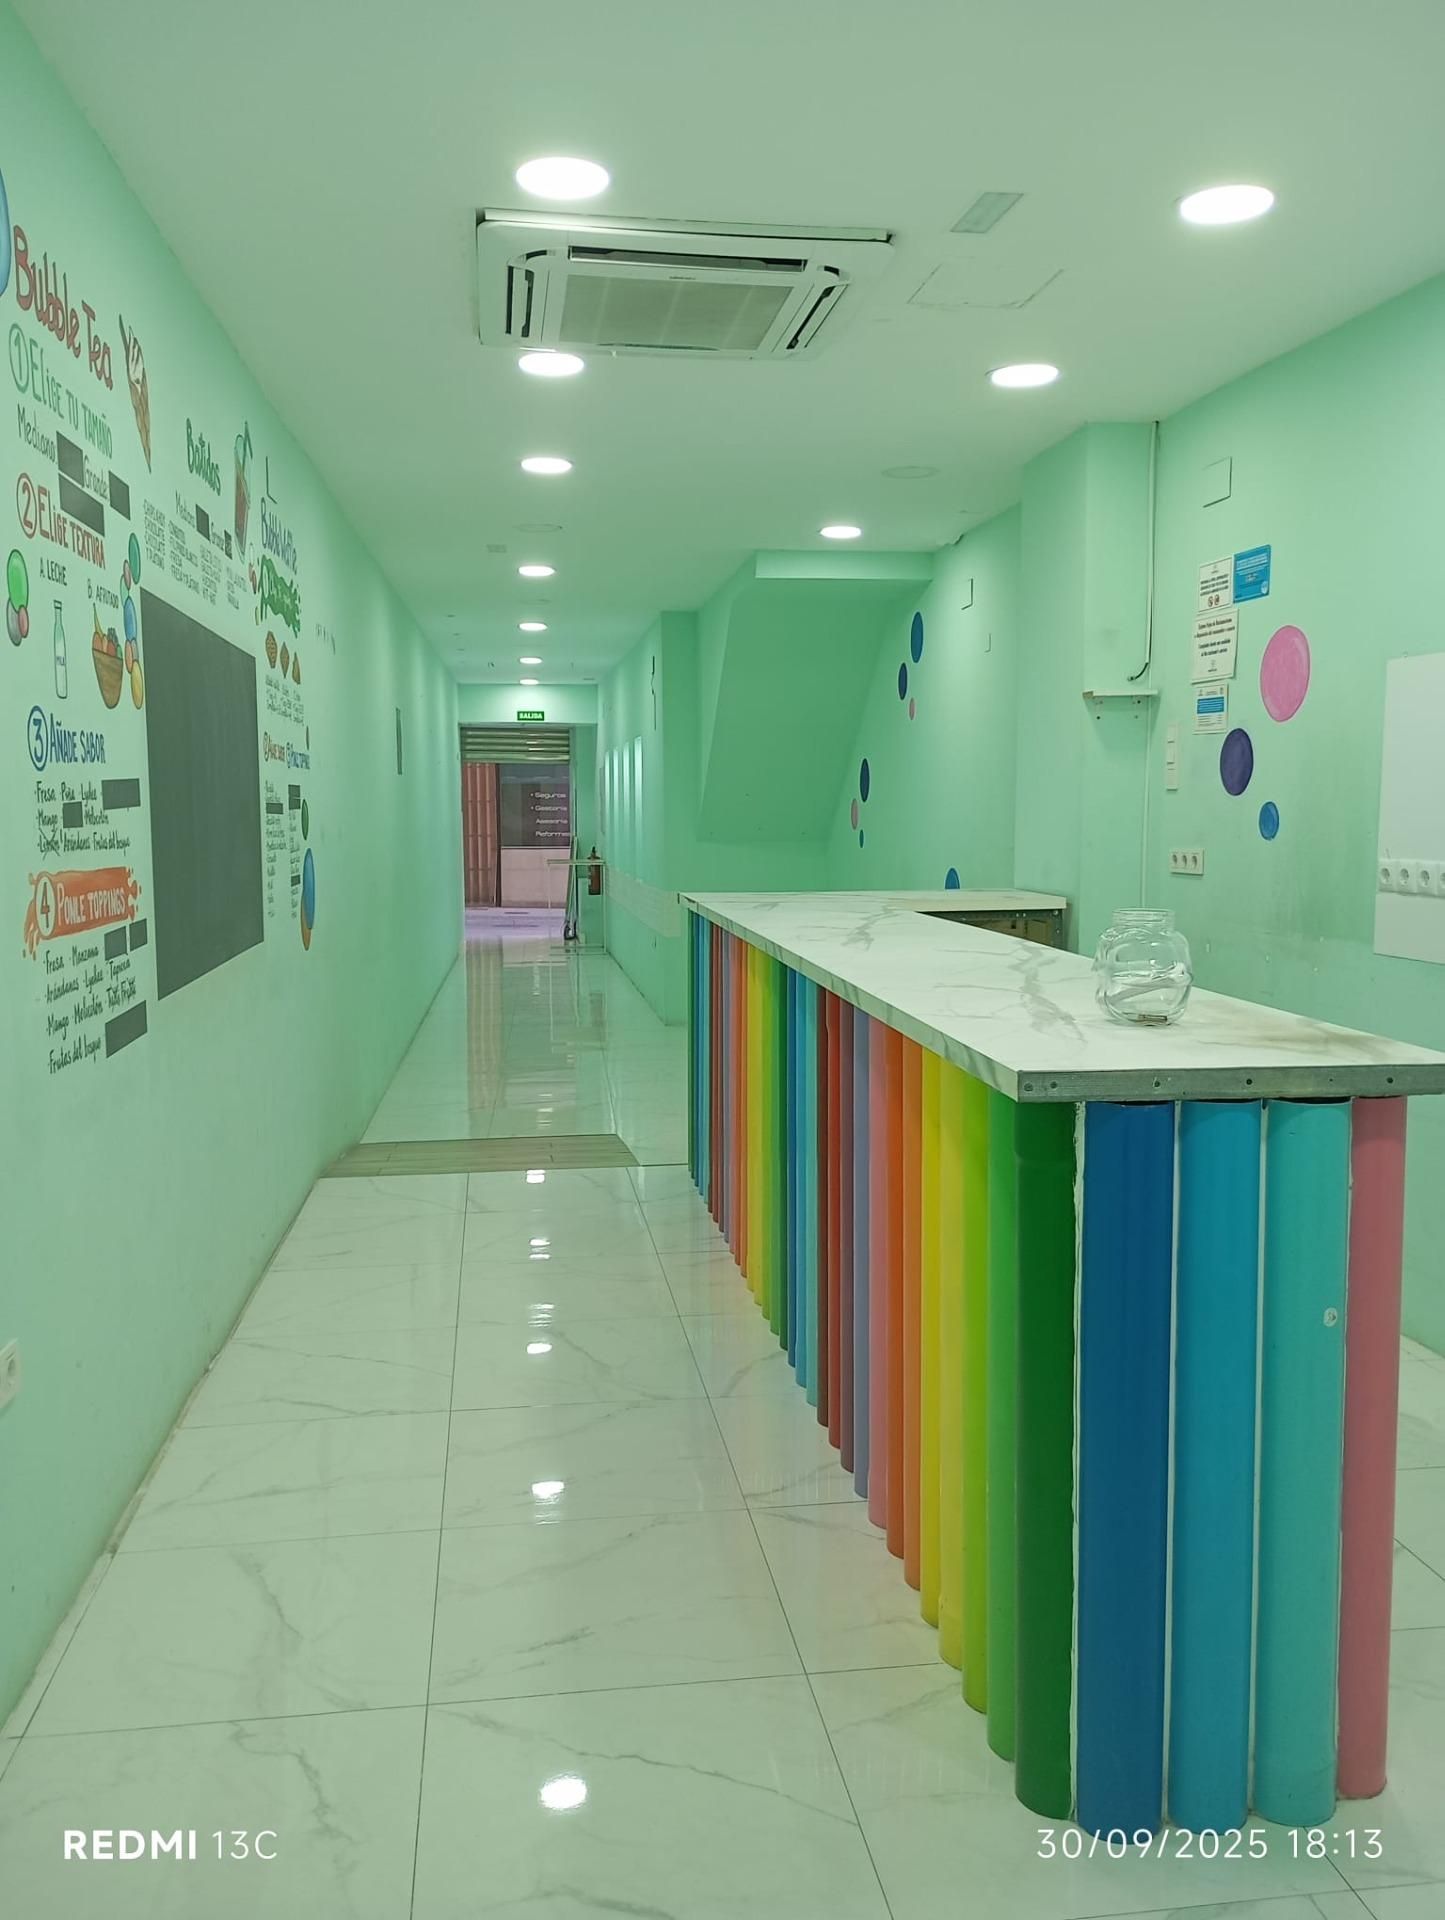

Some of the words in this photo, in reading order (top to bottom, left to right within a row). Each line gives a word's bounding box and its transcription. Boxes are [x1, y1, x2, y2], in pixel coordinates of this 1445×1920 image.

[14, 225, 81, 359] Bubble
[82, 300, 113, 391] Tea
[66, 388, 79, 431] TU
[81, 402, 112, 459] TAMAÑO
[186, 417, 221, 496] Batidos
[69, 520, 106, 570] TEXTURA
[46, 559, 68, 587] LECHE
[519, 711, 543, 720] SALIDA
[50, 712, 79, 764] AÑADE
[79, 729, 106, 764] SABOR
[534, 791, 567, 800] Seguros
[56, 882, 87, 926] PONLE
[86, 887, 127, 921] TOPPINGS
[46, 949, 65, 976] Fresa
[47, 1012, 70, 1042] Mango
